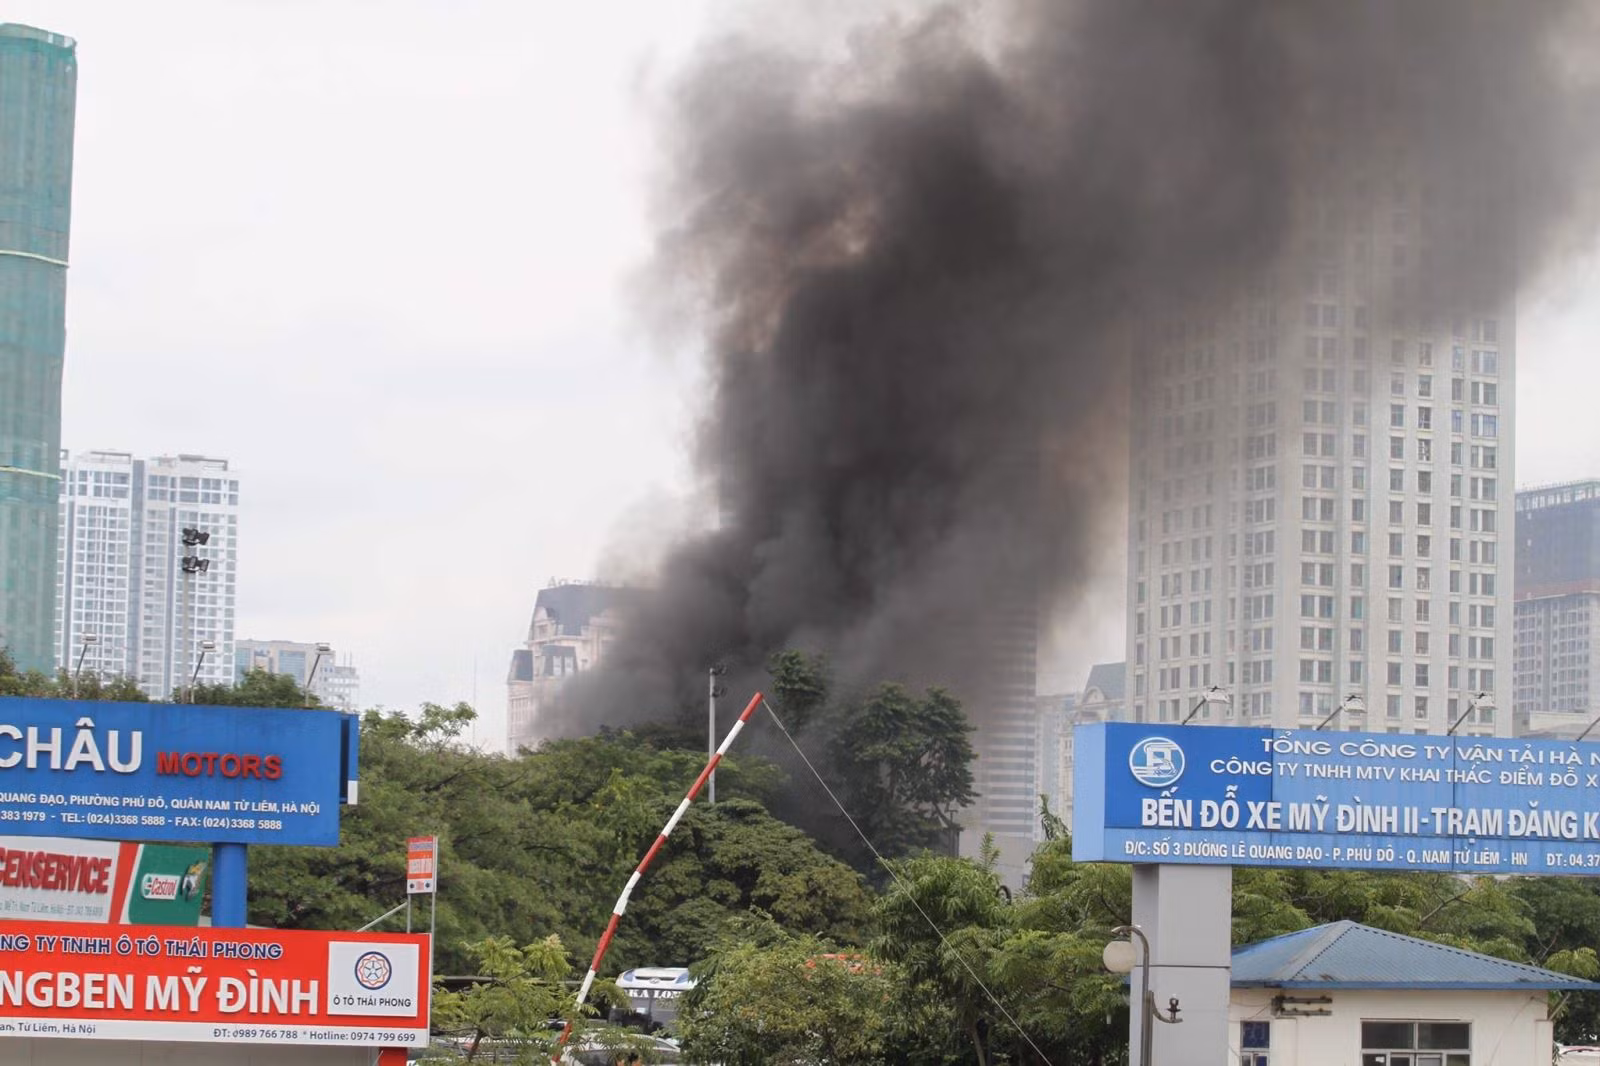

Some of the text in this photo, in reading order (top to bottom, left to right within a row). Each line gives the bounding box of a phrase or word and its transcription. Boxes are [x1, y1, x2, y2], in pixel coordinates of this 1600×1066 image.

[0, 717, 283, 780] CHÂU MOTORS
[1262, 731, 1332, 755] TỔNG
[1340, 739, 1417, 759] CÔNG
[1424, 745, 1450, 760] TY
[1457, 744, 1503, 765] VẬN
[1508, 744, 1544, 764] TẢI
[1550, 746, 1583, 766] HÀ
[1210, 756, 1273, 775] CÔNG
[1278, 762, 1299, 776] TY
[1304, 763, 1351, 779] TNHH
[1356, 766, 1396, 780] MTV
[1400, 767, 1440, 783] KHAI
[1445, 764, 1492, 784] THÁC
[1499, 764, 1543, 786] ĐIỂM
[1585, 774, 1598, 788] X
[205, 800, 230, 811] NAM
[1141, 786, 1193, 828] BẾN
[1200, 785, 1240, 829] ĐỖ
[1246, 801, 1282, 830] XE
[1288, 794, 1330, 832] MỸ
[1336, 795, 1398, 833] ĐÌNH
[1507, 801, 1578, 839] ĐĂNG
[61, 812, 85, 823] TEL:
[141, 815, 165, 826] 5888
[175, 817, 201, 828] FAX:
[258, 820, 282, 830] 5888
[1125, 841, 1150, 855] Đ/C:
[1173, 842, 1180, 855] 3
[1249, 844, 1293, 860] QUANG
[1296, 846, 1322, 864] ĐẠO
[1422, 851, 1450, 864] NAM
[1511, 852, 1527, 865] HN
[36, 935, 58, 952] TY
[61, 936, 112, 955] TNHH
[116, 934, 133, 955] Ô
[135, 935, 160, 956] TÔ
[165, 937, 207, 957] THÁI
[212, 941, 283, 960] PHONG
[145, 965, 208, 1012] MỸ
[216, 969, 319, 1015] ĐÌNH
[333, 995, 341, 1006] Ô
[343, 995, 354, 1006] TÔ
[379, 998, 412, 1008] PHONG
[213, 1028, 230, 1038] ĐT:
[260, 1029, 278, 1039] 766
[280, 1030, 298, 1040] 788
[310, 1031, 348, 1041] Hotline:
[351, 1032, 375, 1041] 0974
[378, 1033, 395, 1042] 799
[398, 1034, 416, 1042] 699
